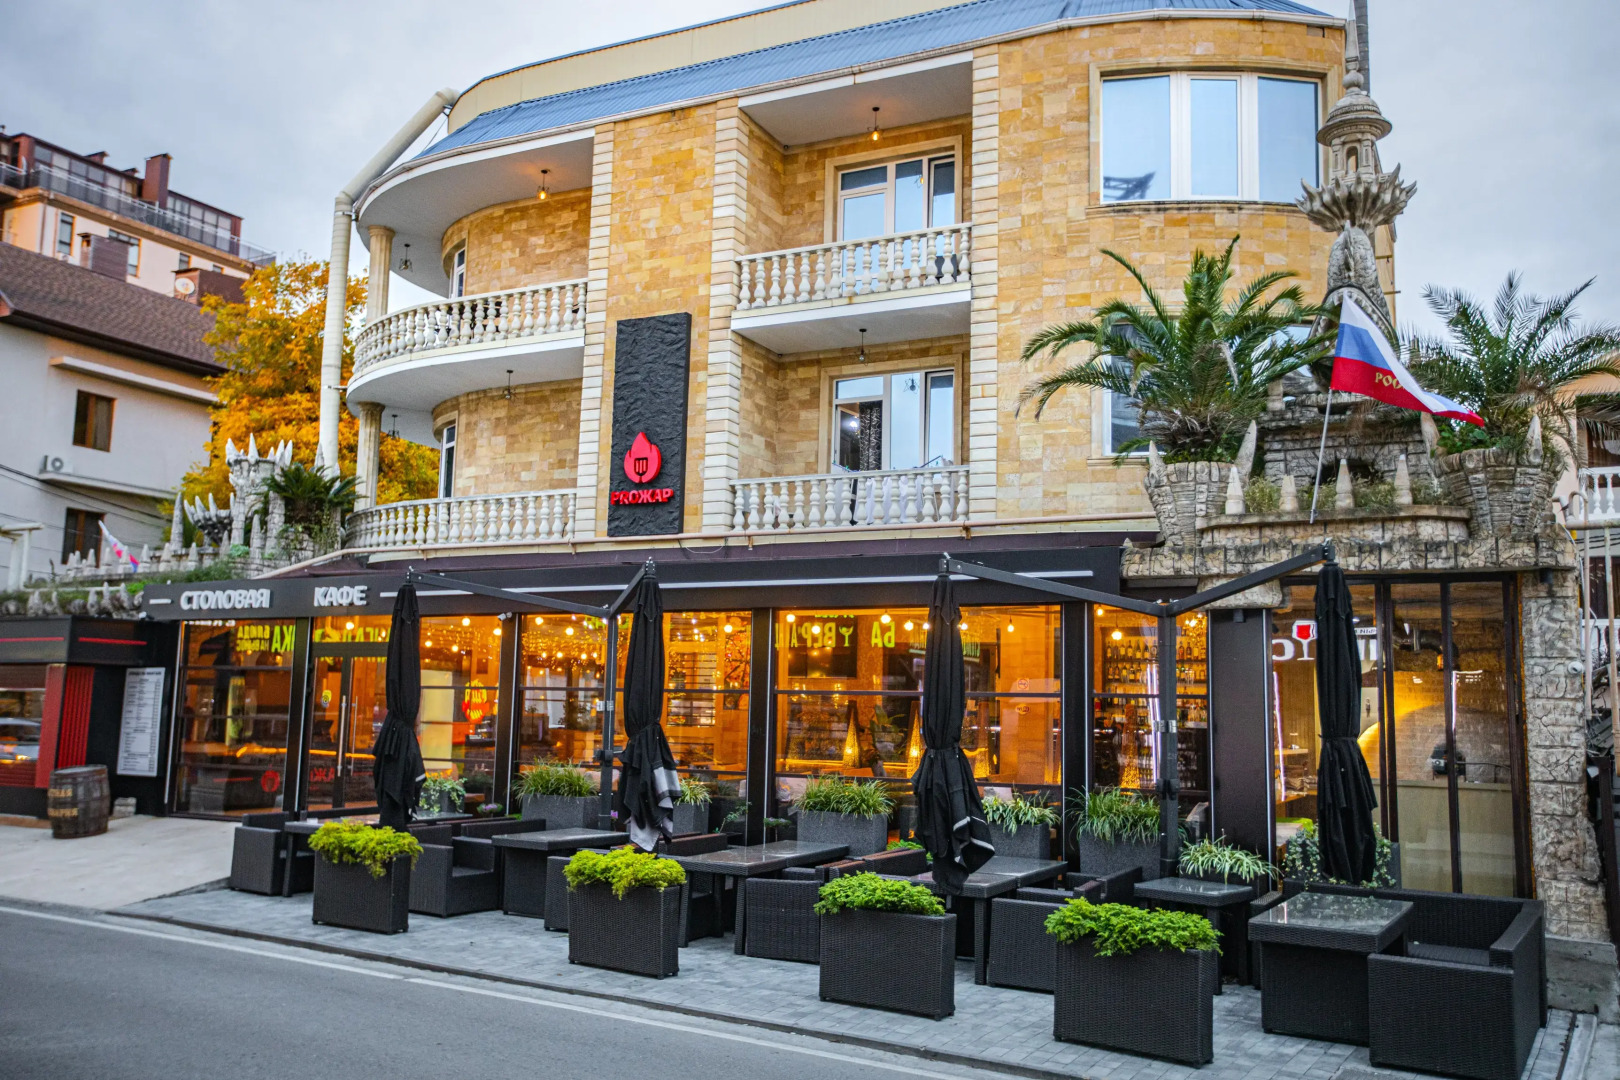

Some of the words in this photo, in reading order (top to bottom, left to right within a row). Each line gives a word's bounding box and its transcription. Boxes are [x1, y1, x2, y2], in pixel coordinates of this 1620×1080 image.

[610, 488, 674, 506] PROЖАР
[180, 588, 271, 610] СТОЛОВАЯ
[313, 585, 368, 607] КАФЕ
